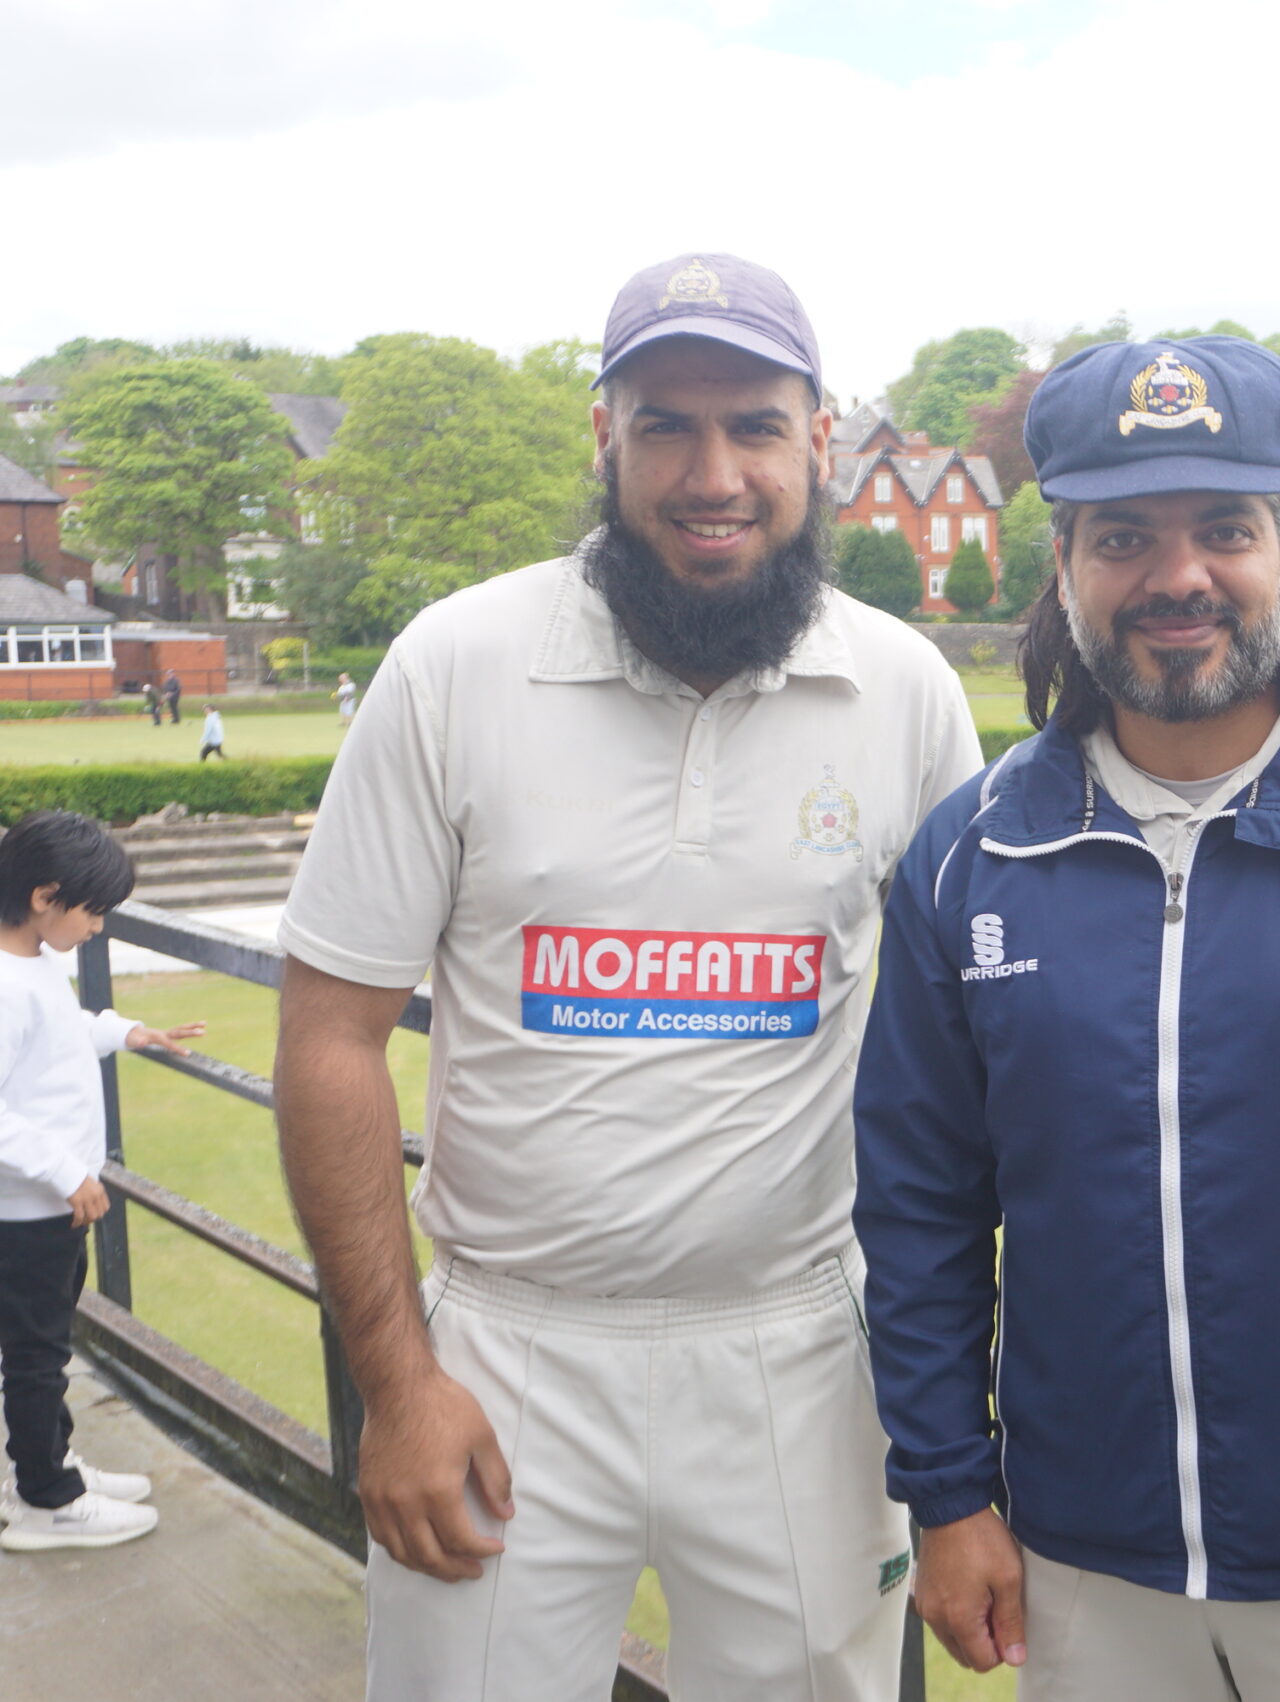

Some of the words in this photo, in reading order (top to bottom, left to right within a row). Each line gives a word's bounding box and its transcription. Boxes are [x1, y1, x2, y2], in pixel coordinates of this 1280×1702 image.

[532, 933, 816, 994] MOFFATTS
[552, 1004, 629, 1030] Motor
[636, 1007, 792, 1032] Accessories
